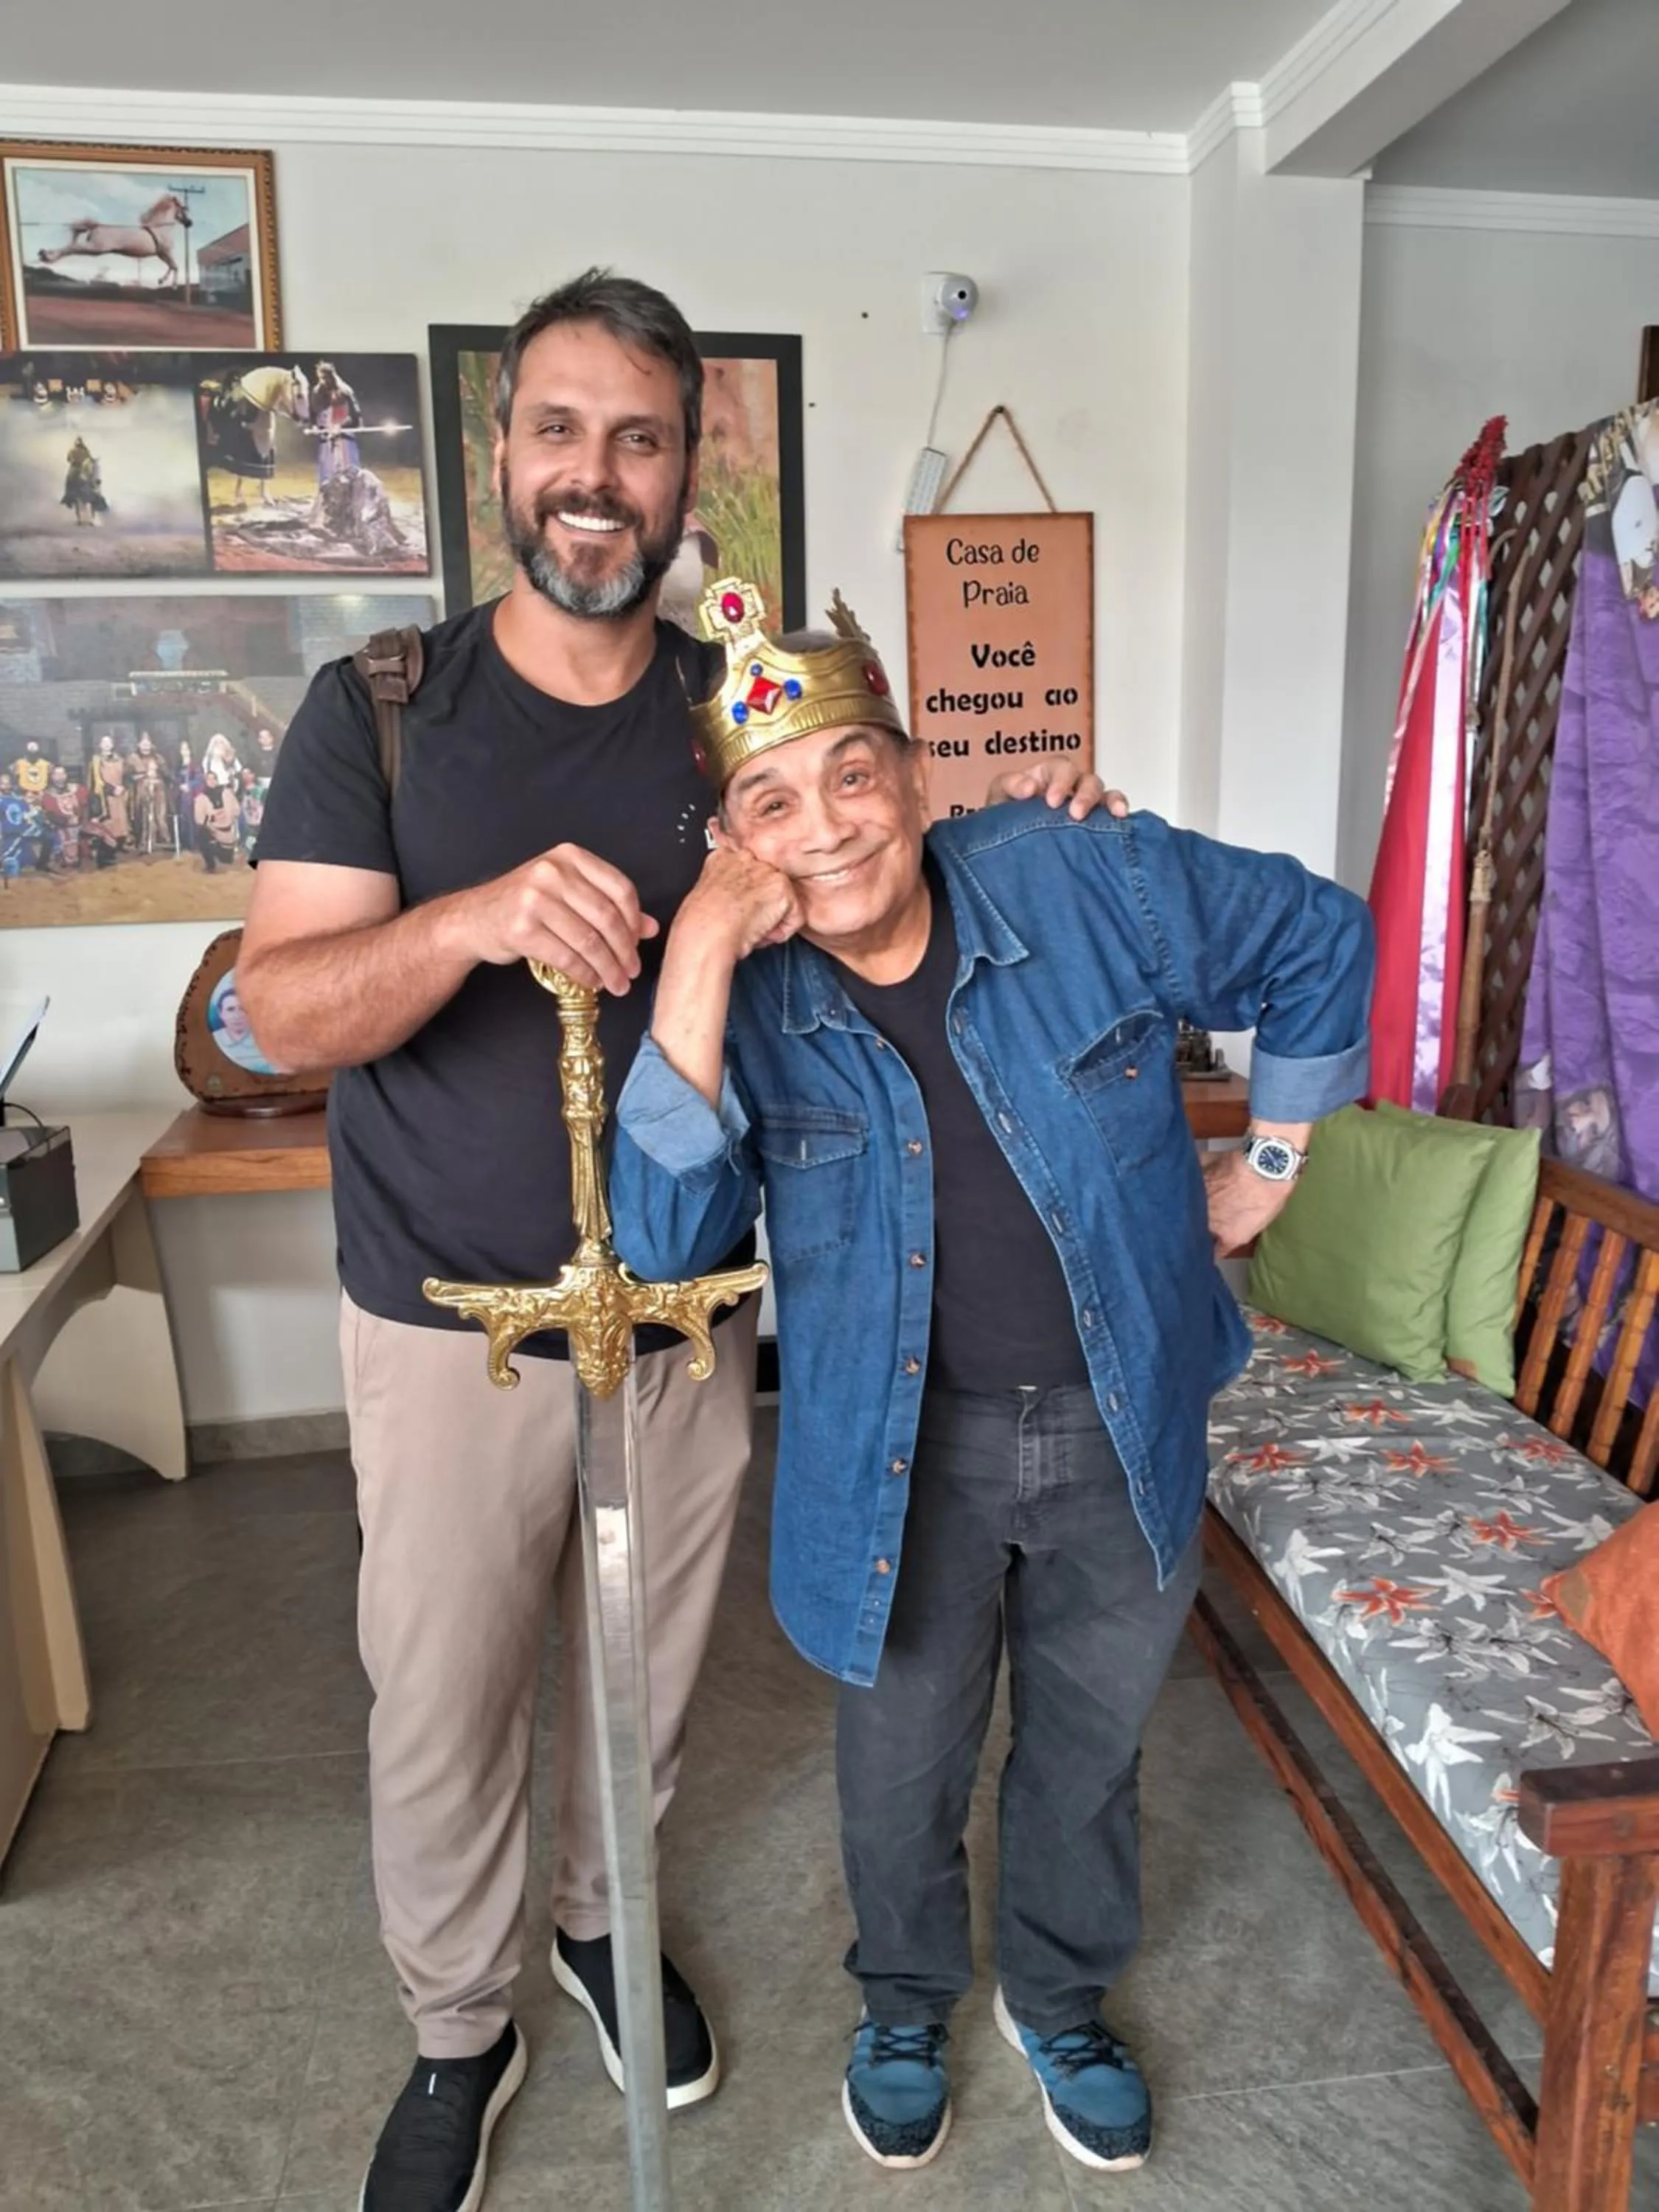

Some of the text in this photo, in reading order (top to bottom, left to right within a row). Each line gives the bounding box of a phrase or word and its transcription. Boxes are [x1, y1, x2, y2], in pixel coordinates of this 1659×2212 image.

[946, 538, 1040, 566] Casa de
[962, 580, 1030, 608] Praia
[971, 640, 1036, 668] Você
[925, 687, 1079, 714] chegou ao
[984, 728, 1081, 755] destino
